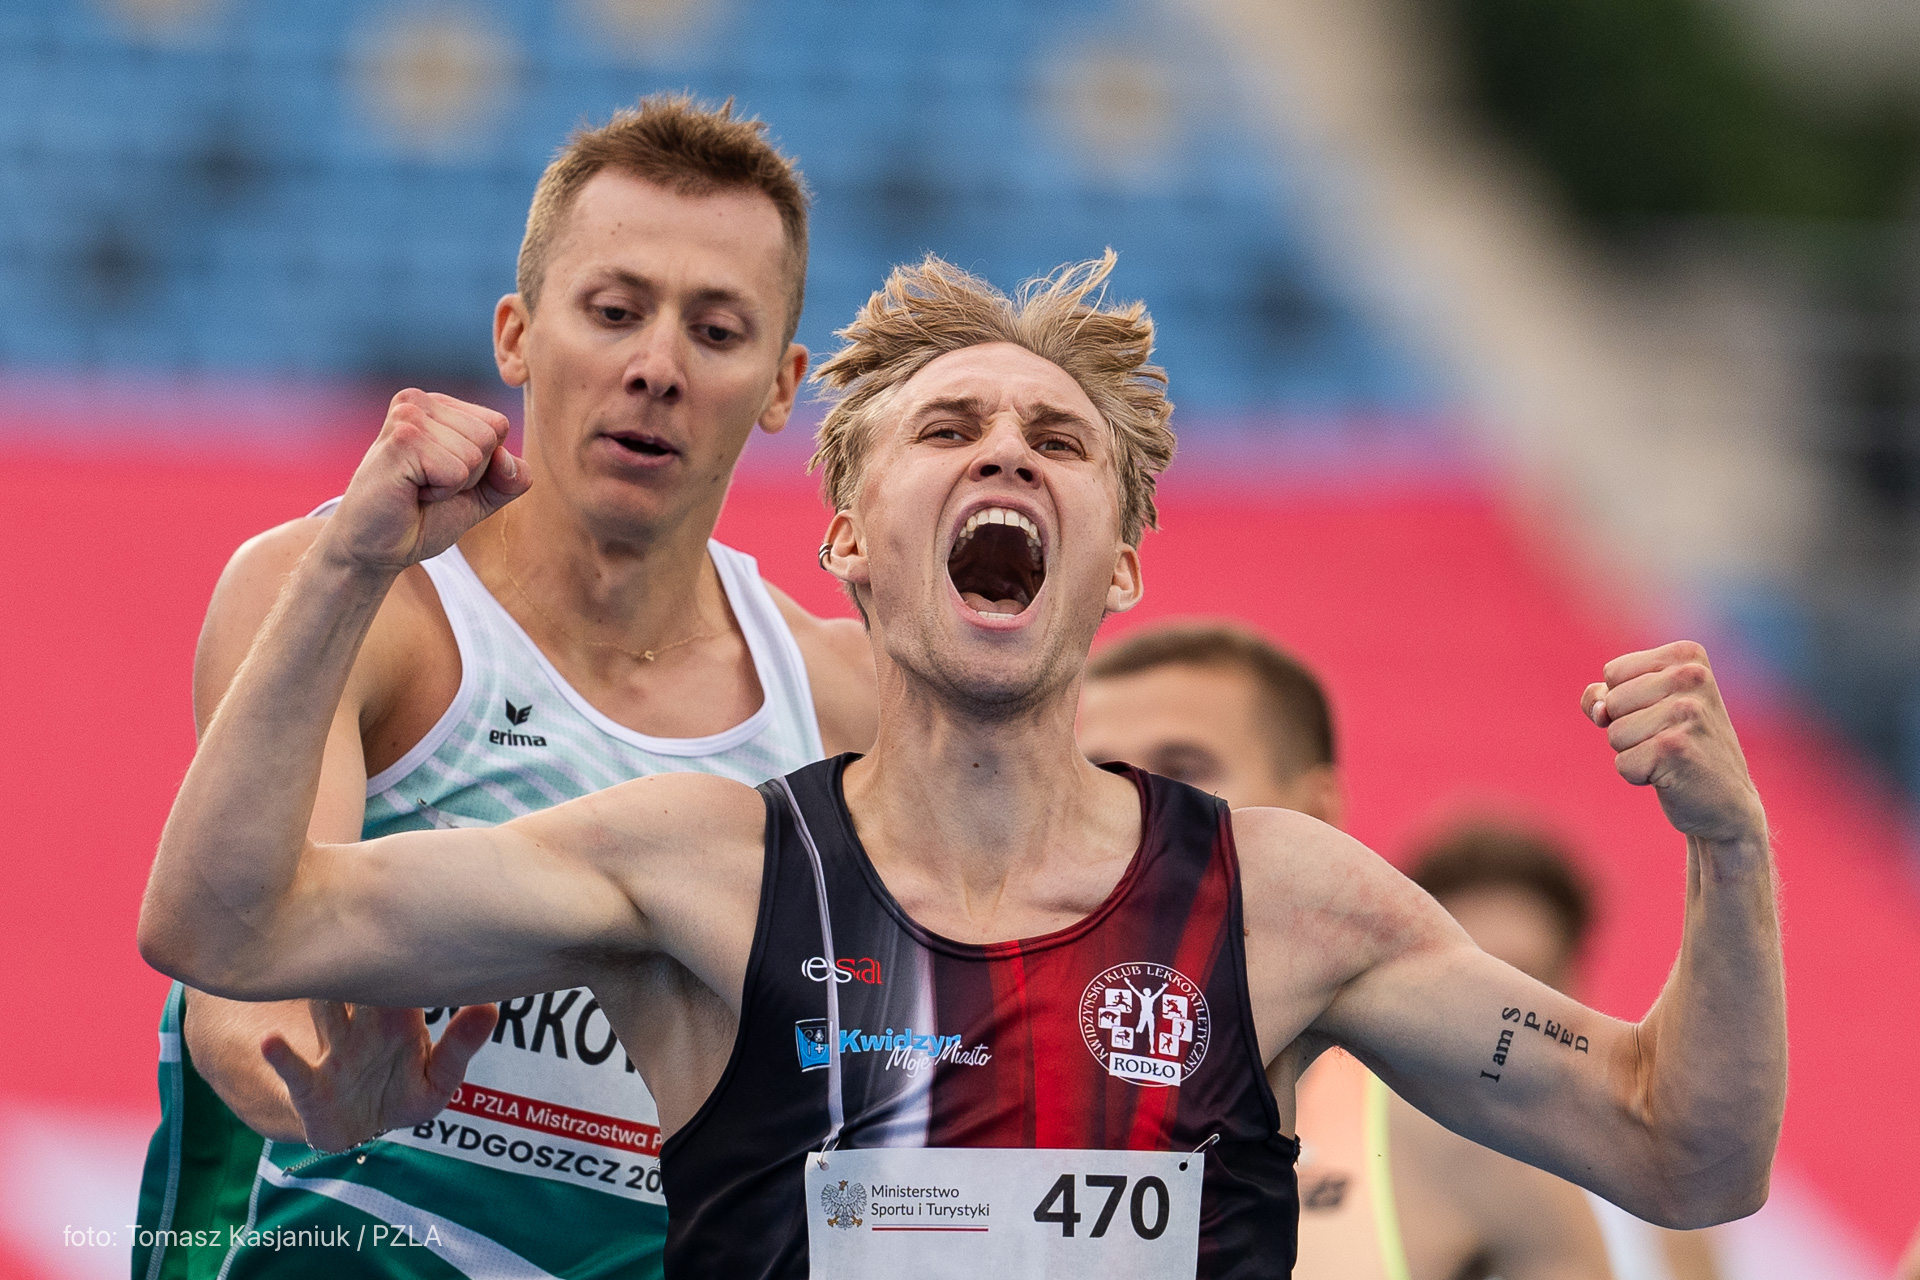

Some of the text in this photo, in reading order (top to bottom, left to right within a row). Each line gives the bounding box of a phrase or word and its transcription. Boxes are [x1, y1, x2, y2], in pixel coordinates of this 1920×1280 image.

[489, 729, 547, 747] erima
[801, 956, 884, 985] esa
[1104, 966, 1141, 984] KLUB
[1147, 966, 1206, 1074] LEKKOATLETYCZNY
[885, 1040, 992, 1078] Moje Miasto
[1480, 1007, 1589, 1083] I am SPEED
[1114, 1058, 1176, 1078] RODŁO
[472, 1092, 520, 1120] PZLA
[525, 1104, 648, 1147] Mistrzostwa
[412, 1118, 621, 1185] BYDGOSZCZ
[871, 1184, 960, 1199] Ministerstwo
[871, 1202, 990, 1219] Sportu i Turystyki
[1033, 1173, 1170, 1240] 470
